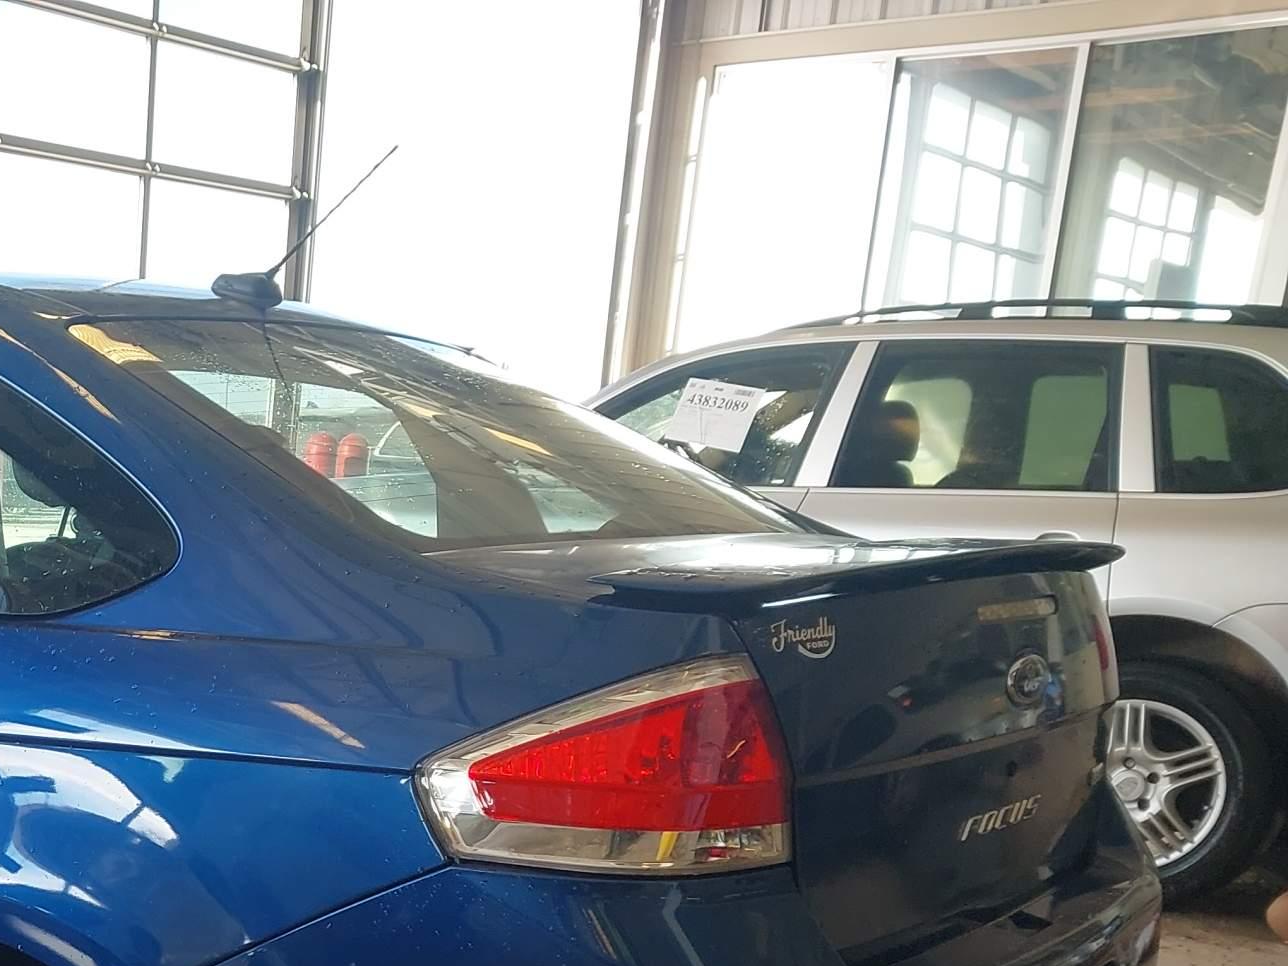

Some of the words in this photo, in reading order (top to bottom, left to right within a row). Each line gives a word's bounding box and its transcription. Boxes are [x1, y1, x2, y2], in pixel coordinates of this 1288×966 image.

[687, 393, 749, 413] 43832089
[770, 616, 836, 659] Friendly
[807, 640, 830, 650] FORD
[960, 794, 1041, 841] FOCUS
